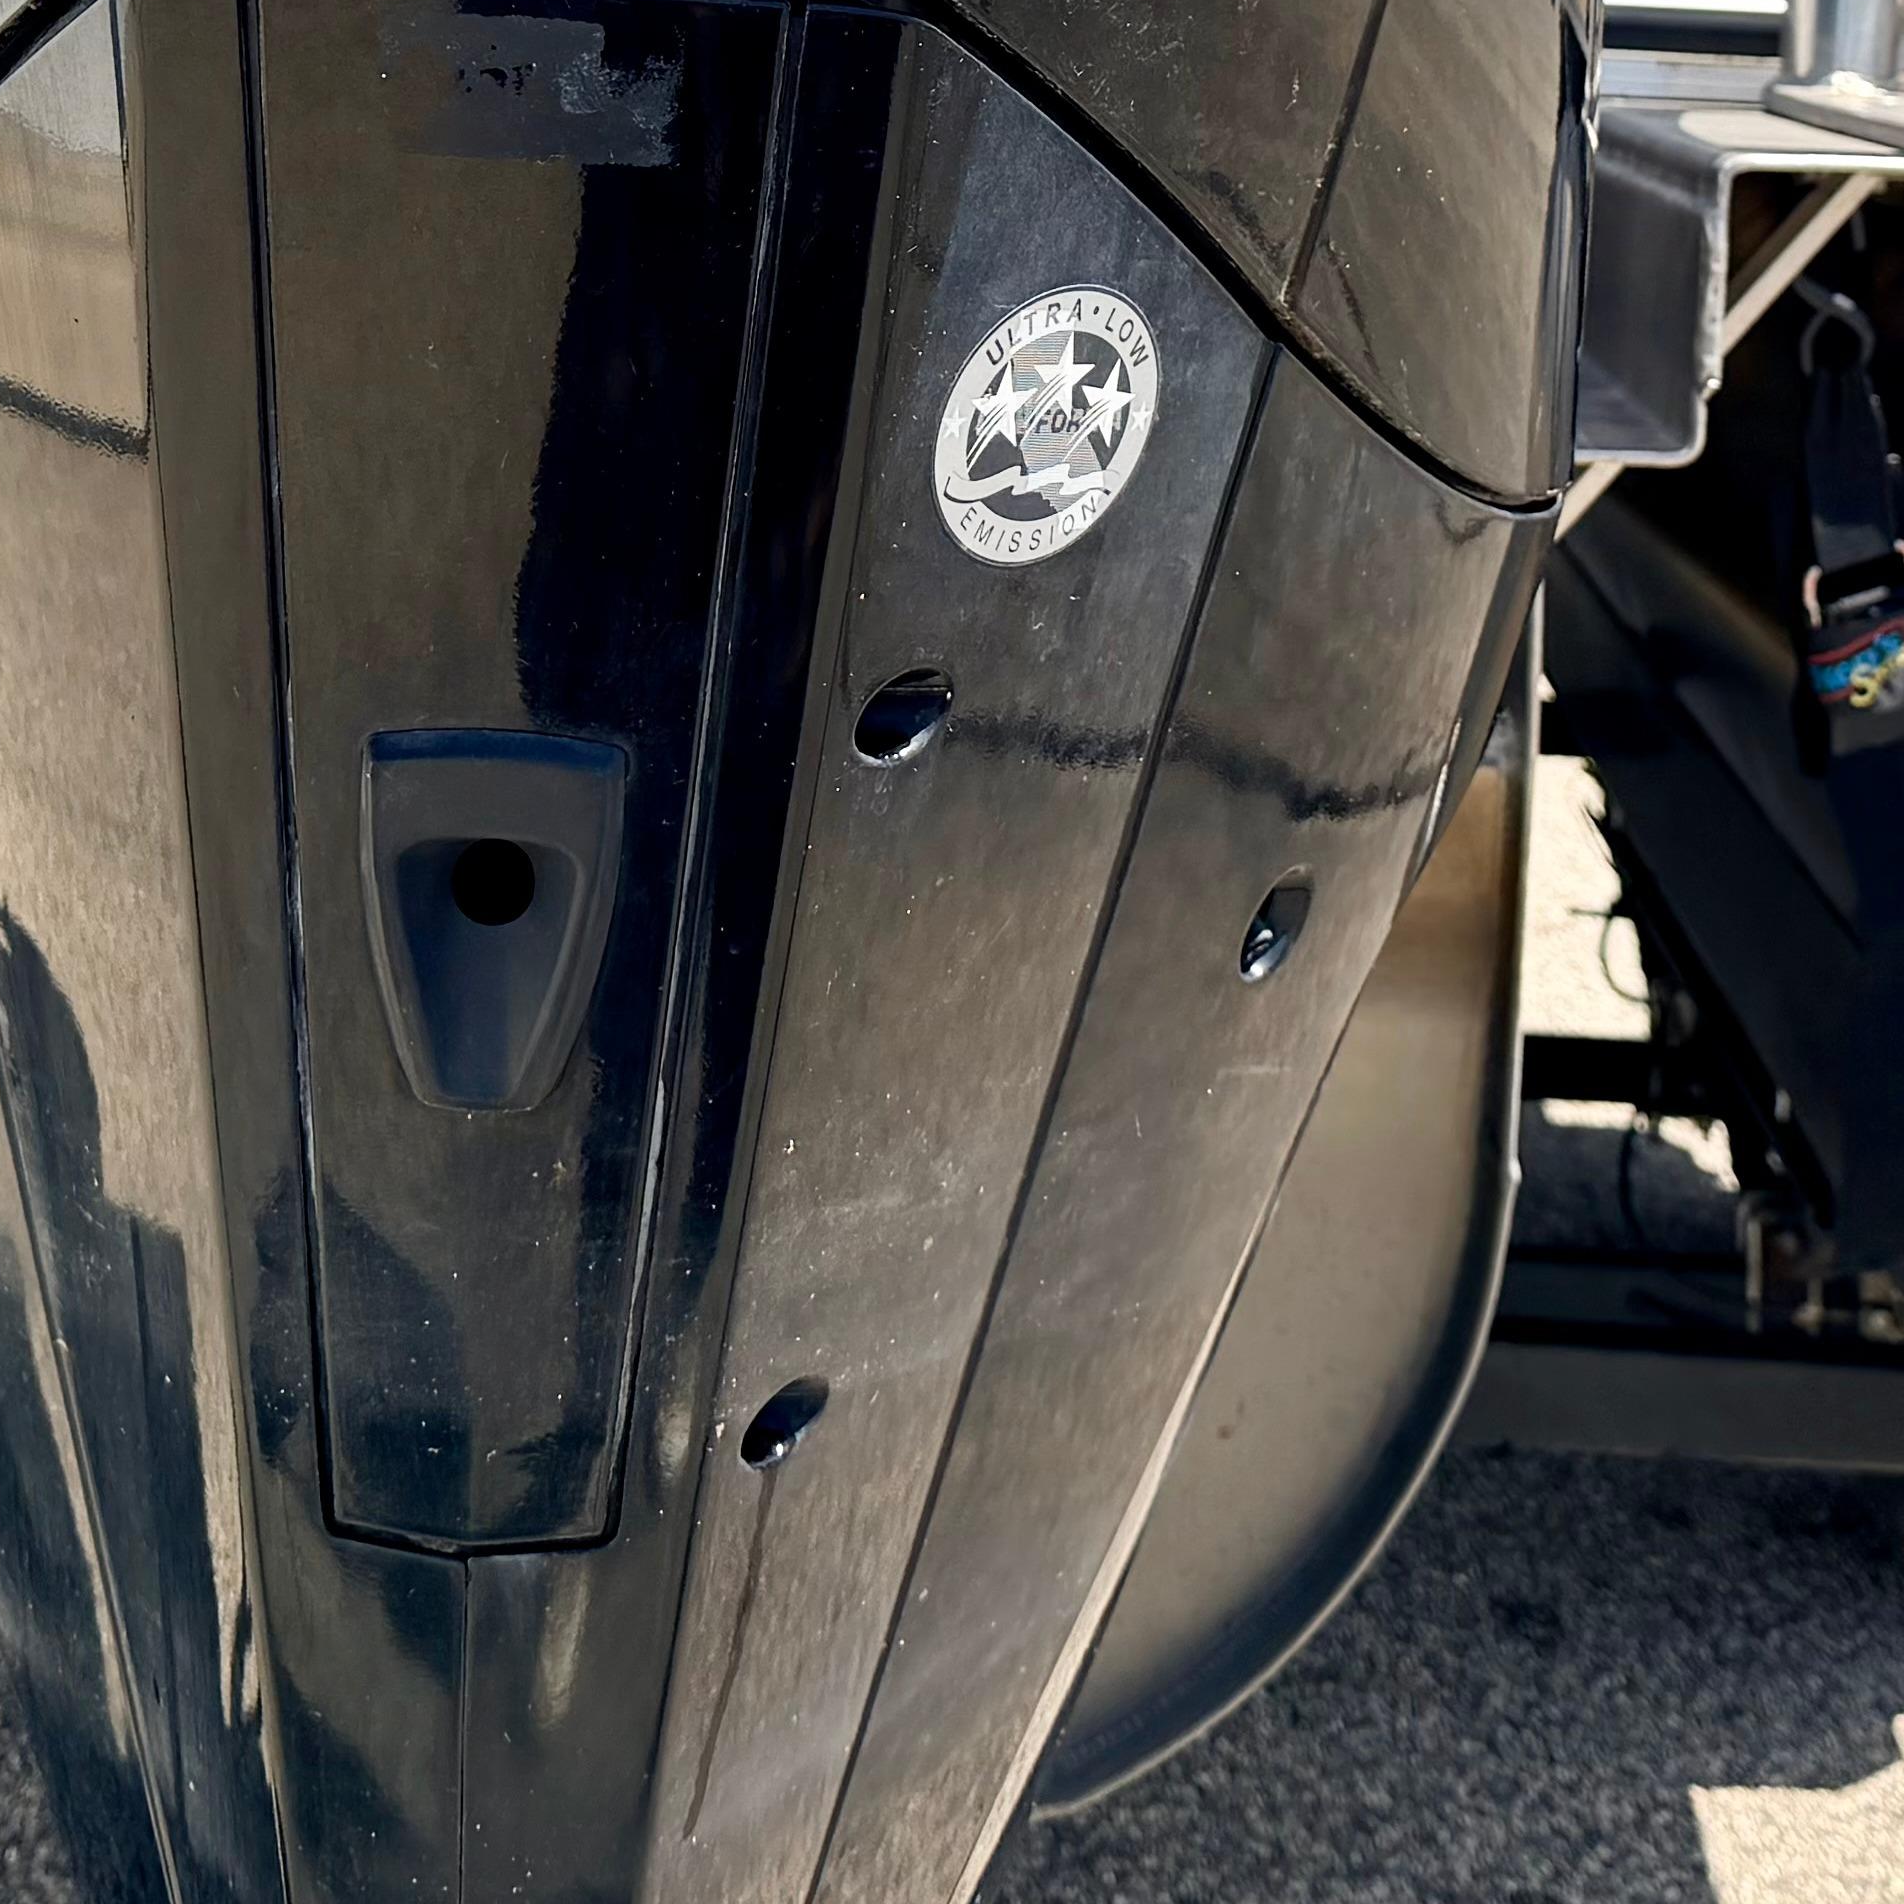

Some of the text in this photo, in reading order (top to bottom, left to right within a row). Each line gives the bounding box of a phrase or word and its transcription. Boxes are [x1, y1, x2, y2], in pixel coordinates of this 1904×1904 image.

[985, 298, 1150, 368] ULTRA LOW
[959, 495, 1099, 553] EMISSION
